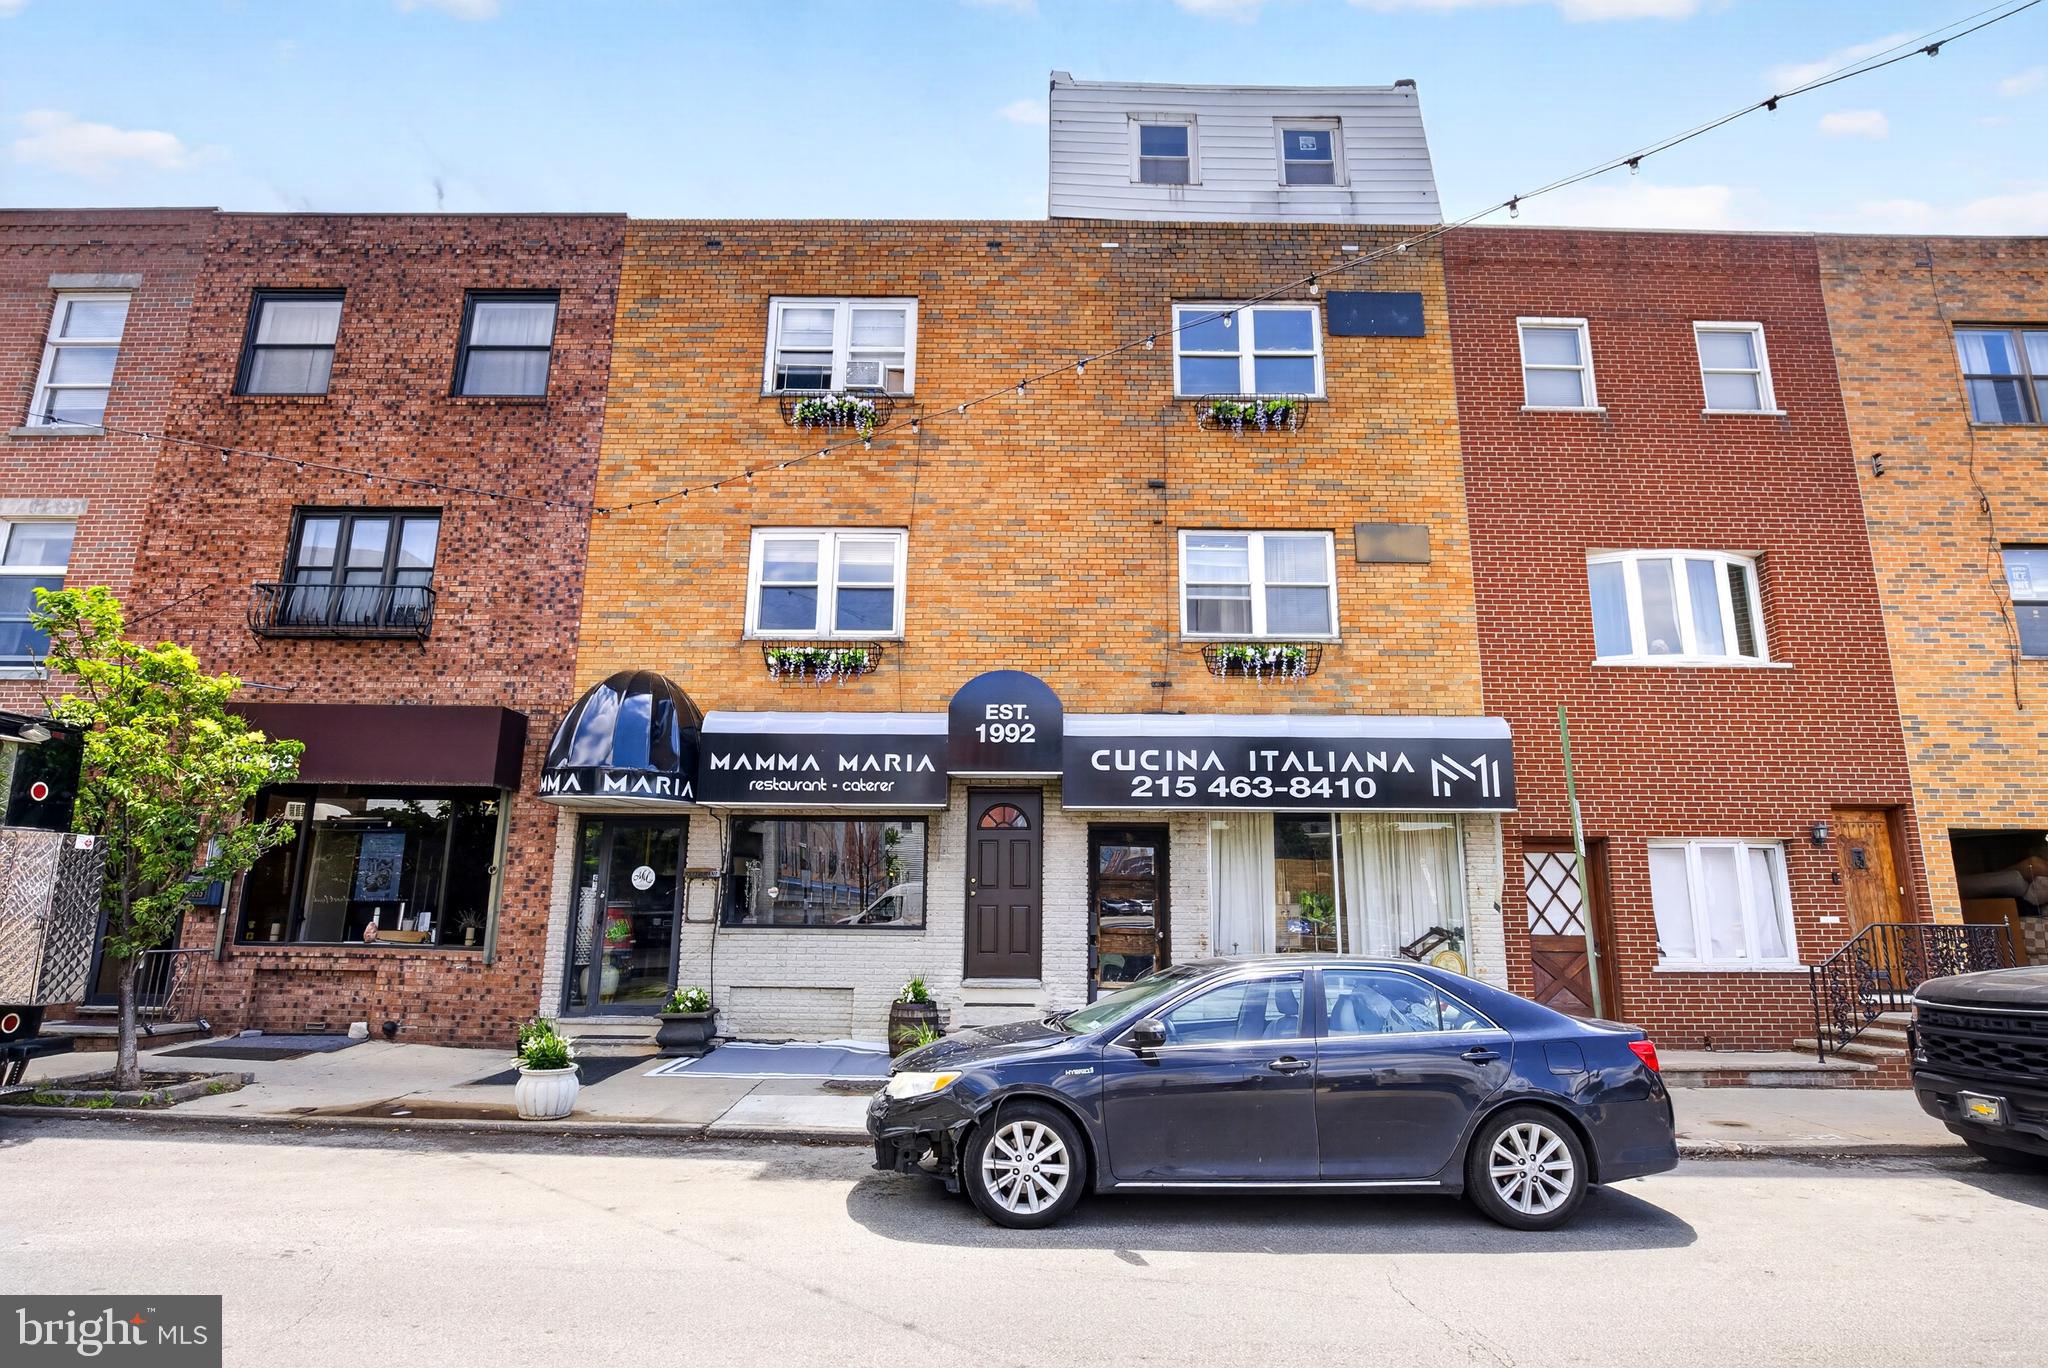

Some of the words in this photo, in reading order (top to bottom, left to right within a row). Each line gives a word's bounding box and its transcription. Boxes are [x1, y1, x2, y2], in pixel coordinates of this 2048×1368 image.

[985, 704, 1030, 720] EST.
[975, 723, 1036, 743] 1992
[710, 752, 821, 771] MAMMA
[838, 753, 936, 772] MARIA
[1091, 749, 1225, 771] CUCINA
[1249, 750, 1415, 773] ITALIANA
[603, 773, 694, 798] MARIA
[749, 777, 827, 791] restaurant
[842, 778, 895, 792] caterer
[1130, 775, 1197, 797] 215
[1207, 776, 1377, 798] 463-8410
